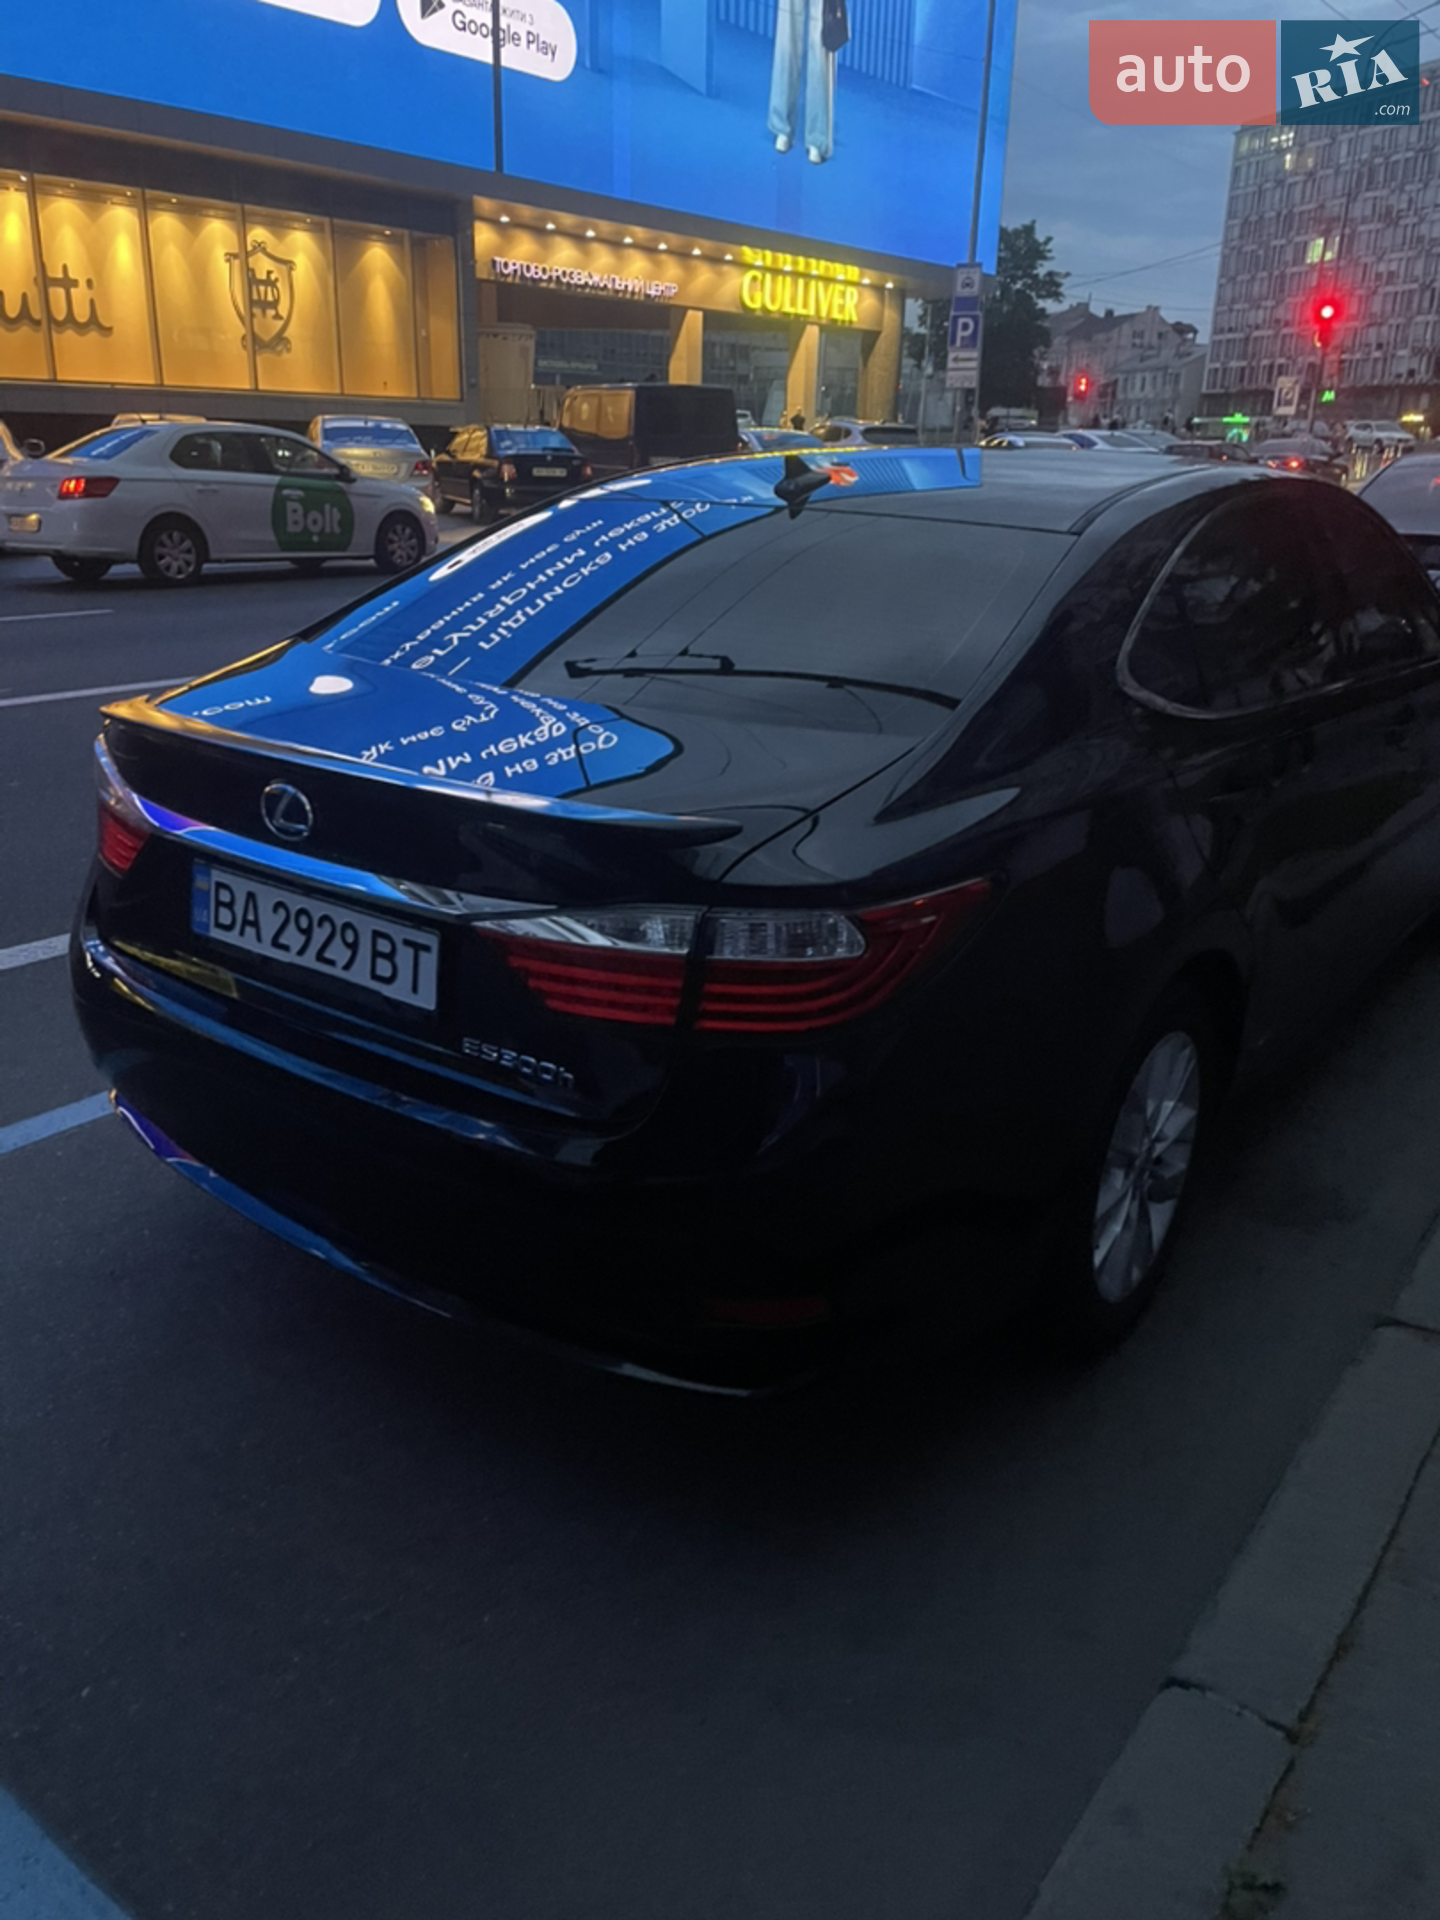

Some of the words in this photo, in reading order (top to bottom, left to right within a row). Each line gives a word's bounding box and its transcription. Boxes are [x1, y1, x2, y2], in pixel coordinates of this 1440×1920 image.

[452, 10, 522, 48] Google
[526, 31, 558, 63] Play
[742, 270, 858, 322] GULLIVER
[956, 317, 975, 347] P
[286, 501, 342, 542] Bolt
[214, 881, 262, 944] BA
[271, 900, 360, 971] 2929
[370, 929, 432, 995] BT
